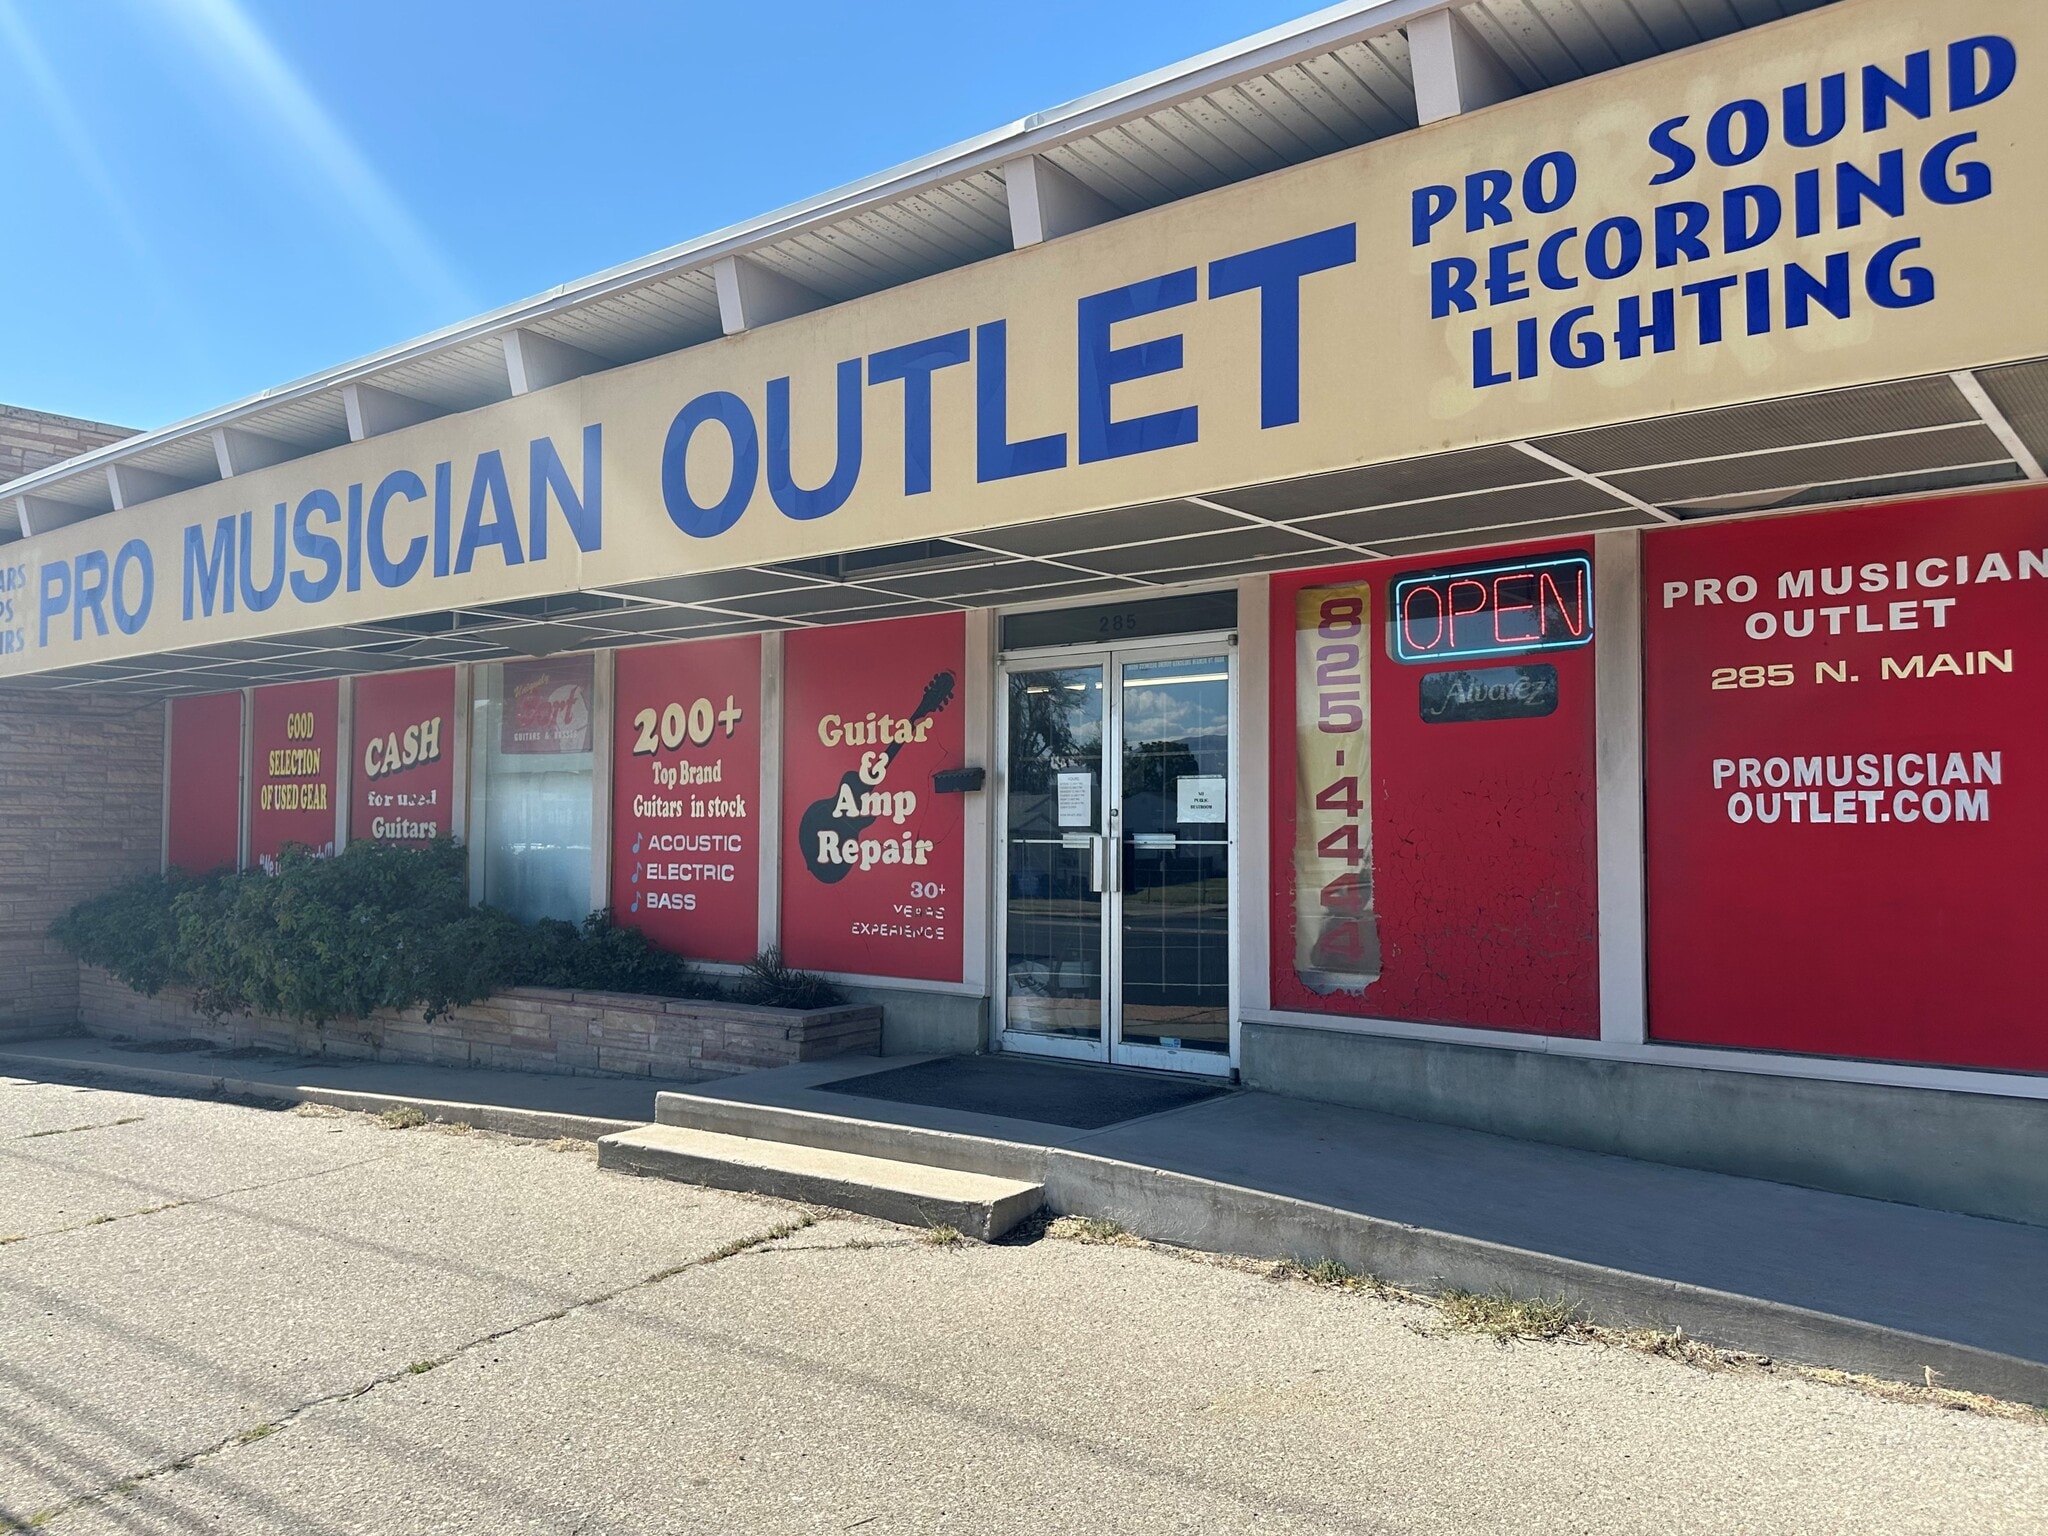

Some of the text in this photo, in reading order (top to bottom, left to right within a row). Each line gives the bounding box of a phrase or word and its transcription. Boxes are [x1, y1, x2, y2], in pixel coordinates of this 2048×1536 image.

[1412, 35, 2017, 247] PRO SOUND
[1431, 131, 1992, 320] RECORDING
[1473, 238, 1935, 388] LIGHTING
[39, 222, 1356, 648] PRO MUSICIAN OUTLET
[1663, 548, 2048, 609] PRO MUSICIAN
[1099, 614, 1136, 632] 285
[1404, 570, 1583, 650] OPEN
[1745, 597, 1956, 640] OUTLET
[1711, 649, 2013, 690] 285 N. MAIN
[1431, 674, 1547, 715] Alvarez
[288, 712, 314, 740] GOOD
[633, 695, 742, 755] 200+
[818, 712, 934, 747] Guitar
[269, 748, 321, 776] SELECTION
[365, 717, 441, 777] CASH
[652, 759, 722, 790] Top Brand
[859, 751, 889, 785] &
[1315, 597, 1364, 965] 825-4444
[1712, 751, 2002, 789] PROMUSICIAN
[261, 783, 327, 810] OF USED GEAR
[368, 791, 393, 806] for
[633, 794, 746, 817] Guitars in stock
[832, 783, 917, 824] Amp
[1727, 789, 1990, 824] OUTLET.COM
[372, 816, 437, 839] Guitars
[648, 834, 742, 852] ACOUSTIC
[817, 831, 934, 871] Repair
[646, 863, 735, 881] ELECTRIC
[910, 881, 946, 898] 30+
[646, 892, 696, 910] BASS
